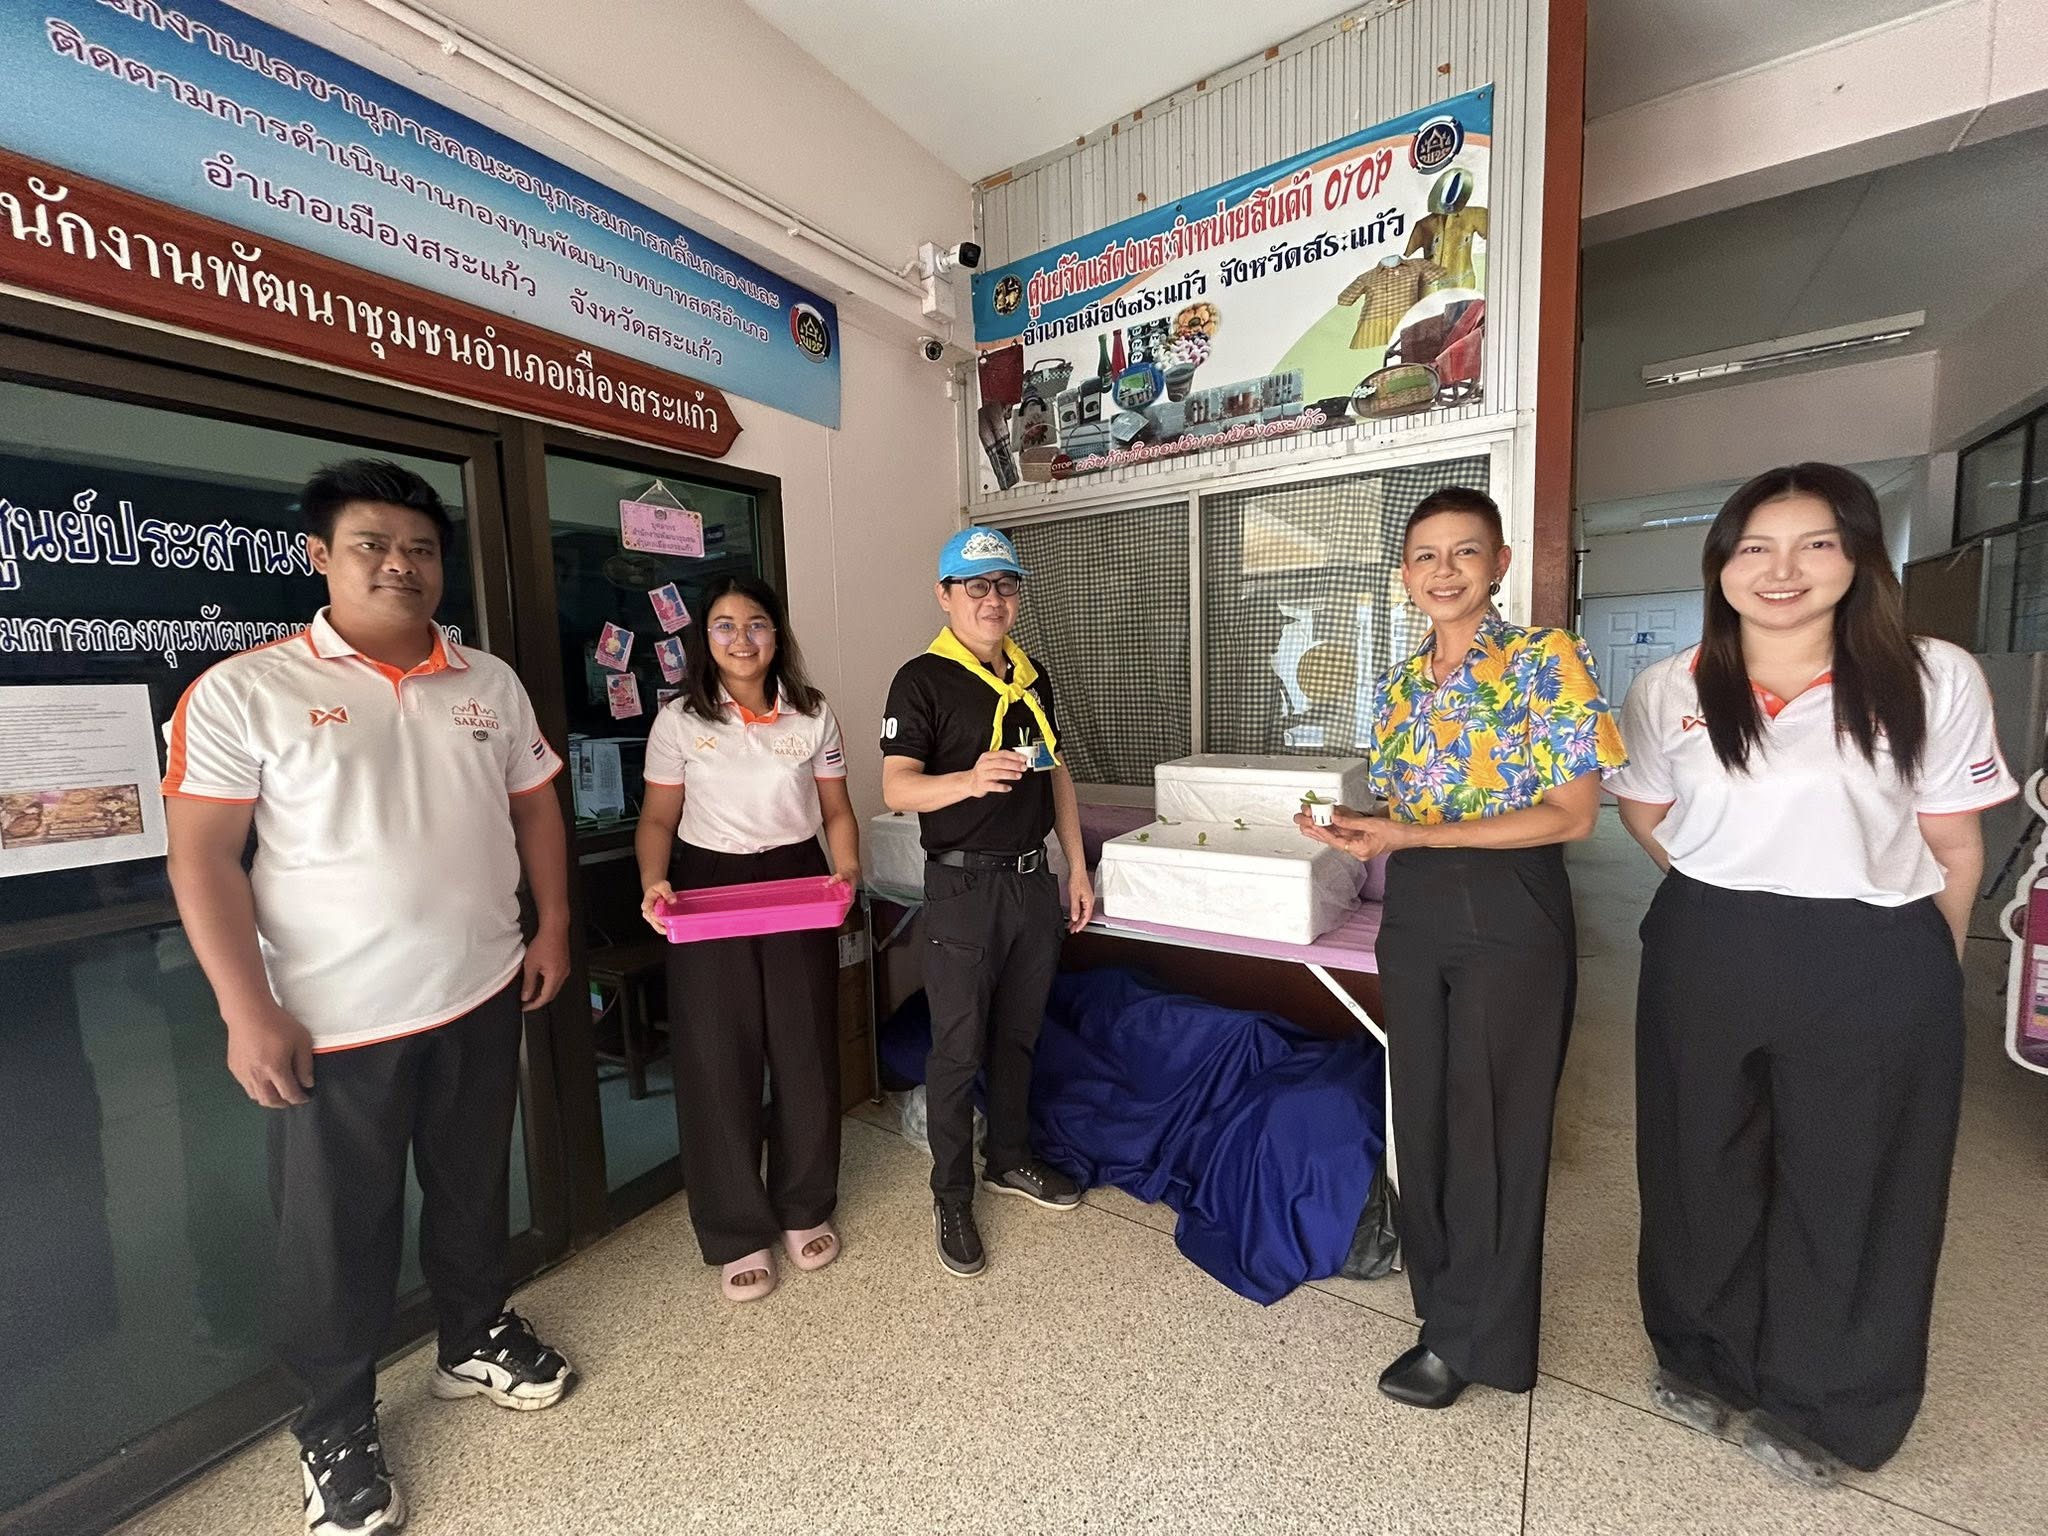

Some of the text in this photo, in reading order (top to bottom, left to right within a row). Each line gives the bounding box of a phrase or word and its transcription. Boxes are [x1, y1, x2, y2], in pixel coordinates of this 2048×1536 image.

[45, 16, 770, 343] ติดตามการดำเนินงานกองทุนพัฒนาบทบาทสตรีอำเภอ
[202, 152, 723, 366] อำเภอเมืองสระแก้ว จังหวัดสระแก้ว
[1027, 149, 1394, 318] ศูนย์จัดแสดงและจำหน่ายสินค้า OTOP
[1022, 269, 1208, 346] อำเภอเมืองสระแก้ว
[1220, 207, 1405, 288] จังหวัดสระแก้ว
[454, 716, 499, 730] SAKAEO
